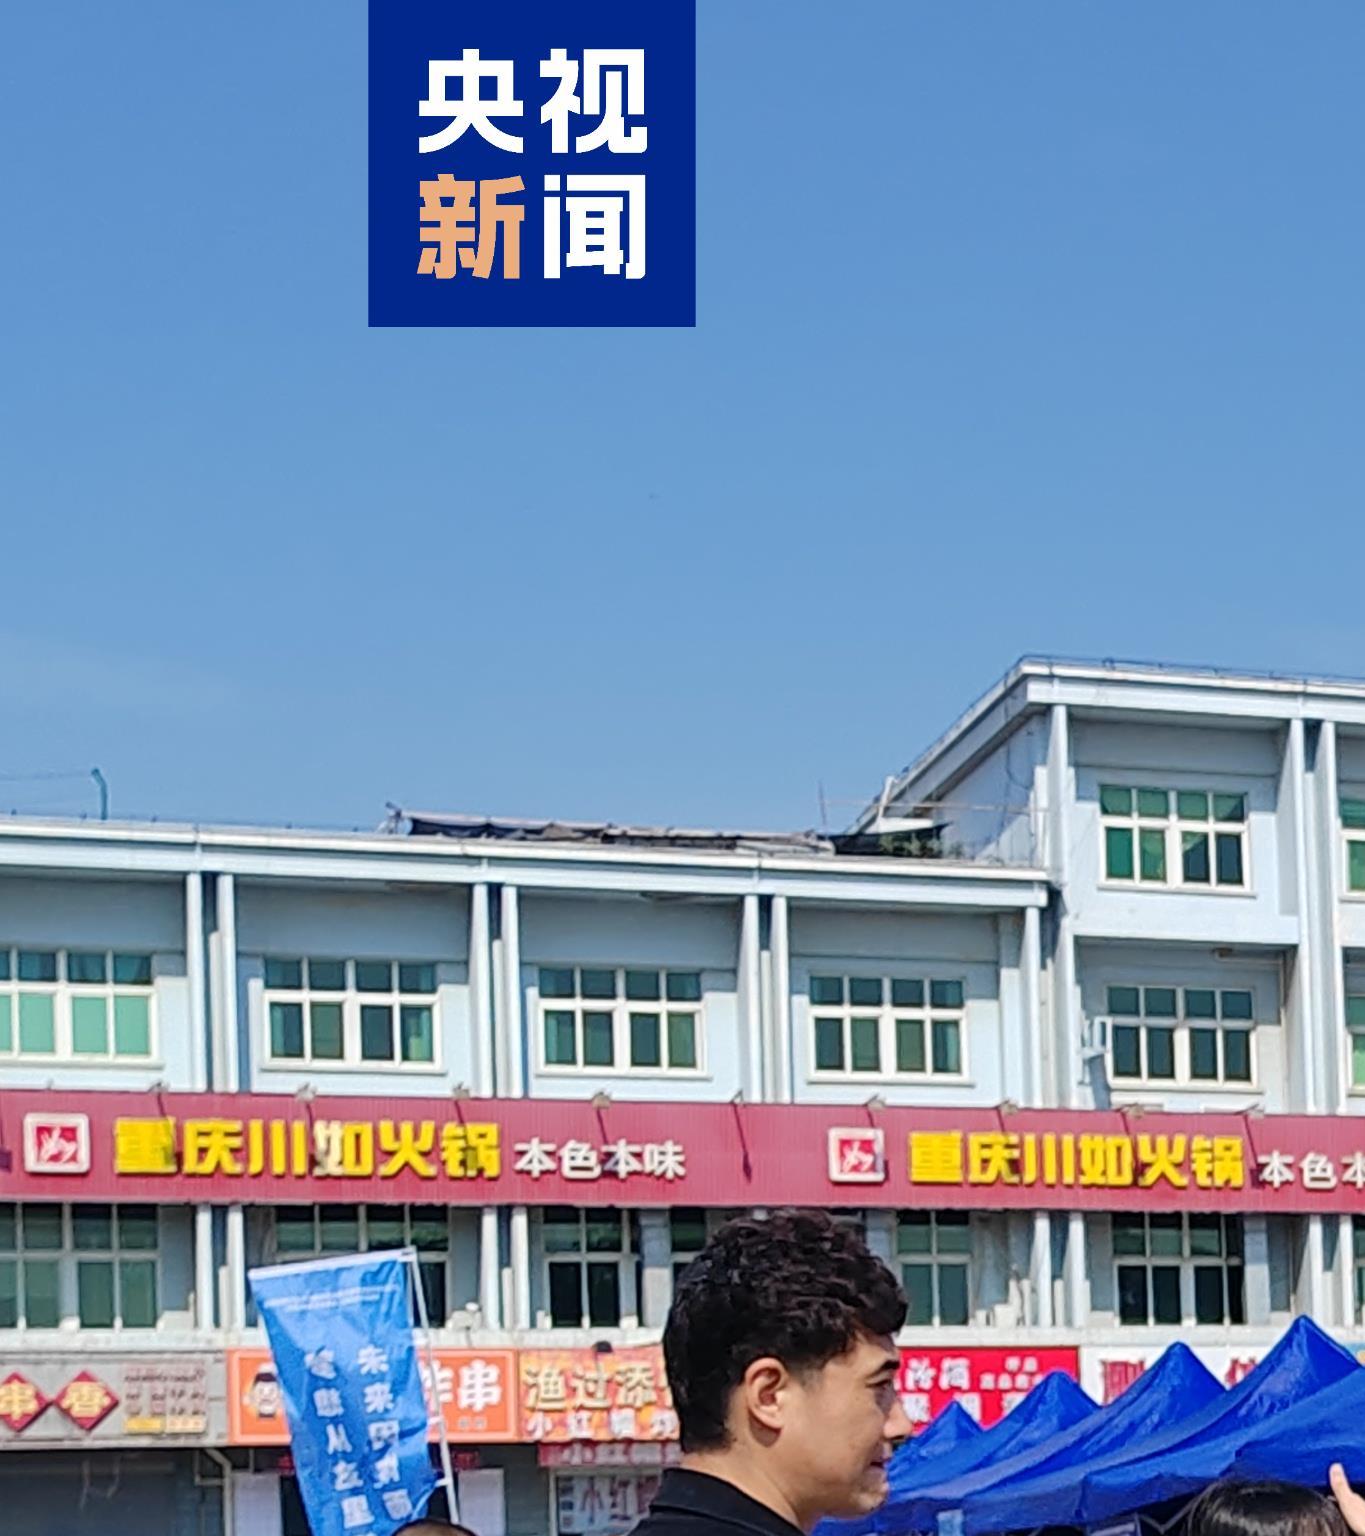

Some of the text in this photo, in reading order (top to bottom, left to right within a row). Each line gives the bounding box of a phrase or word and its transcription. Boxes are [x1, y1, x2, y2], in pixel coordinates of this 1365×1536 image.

[114, 1117, 687, 1181] 重庆川如火锅 本色本味
[909, 1130, 1247, 1189] 重庆川如火锅
